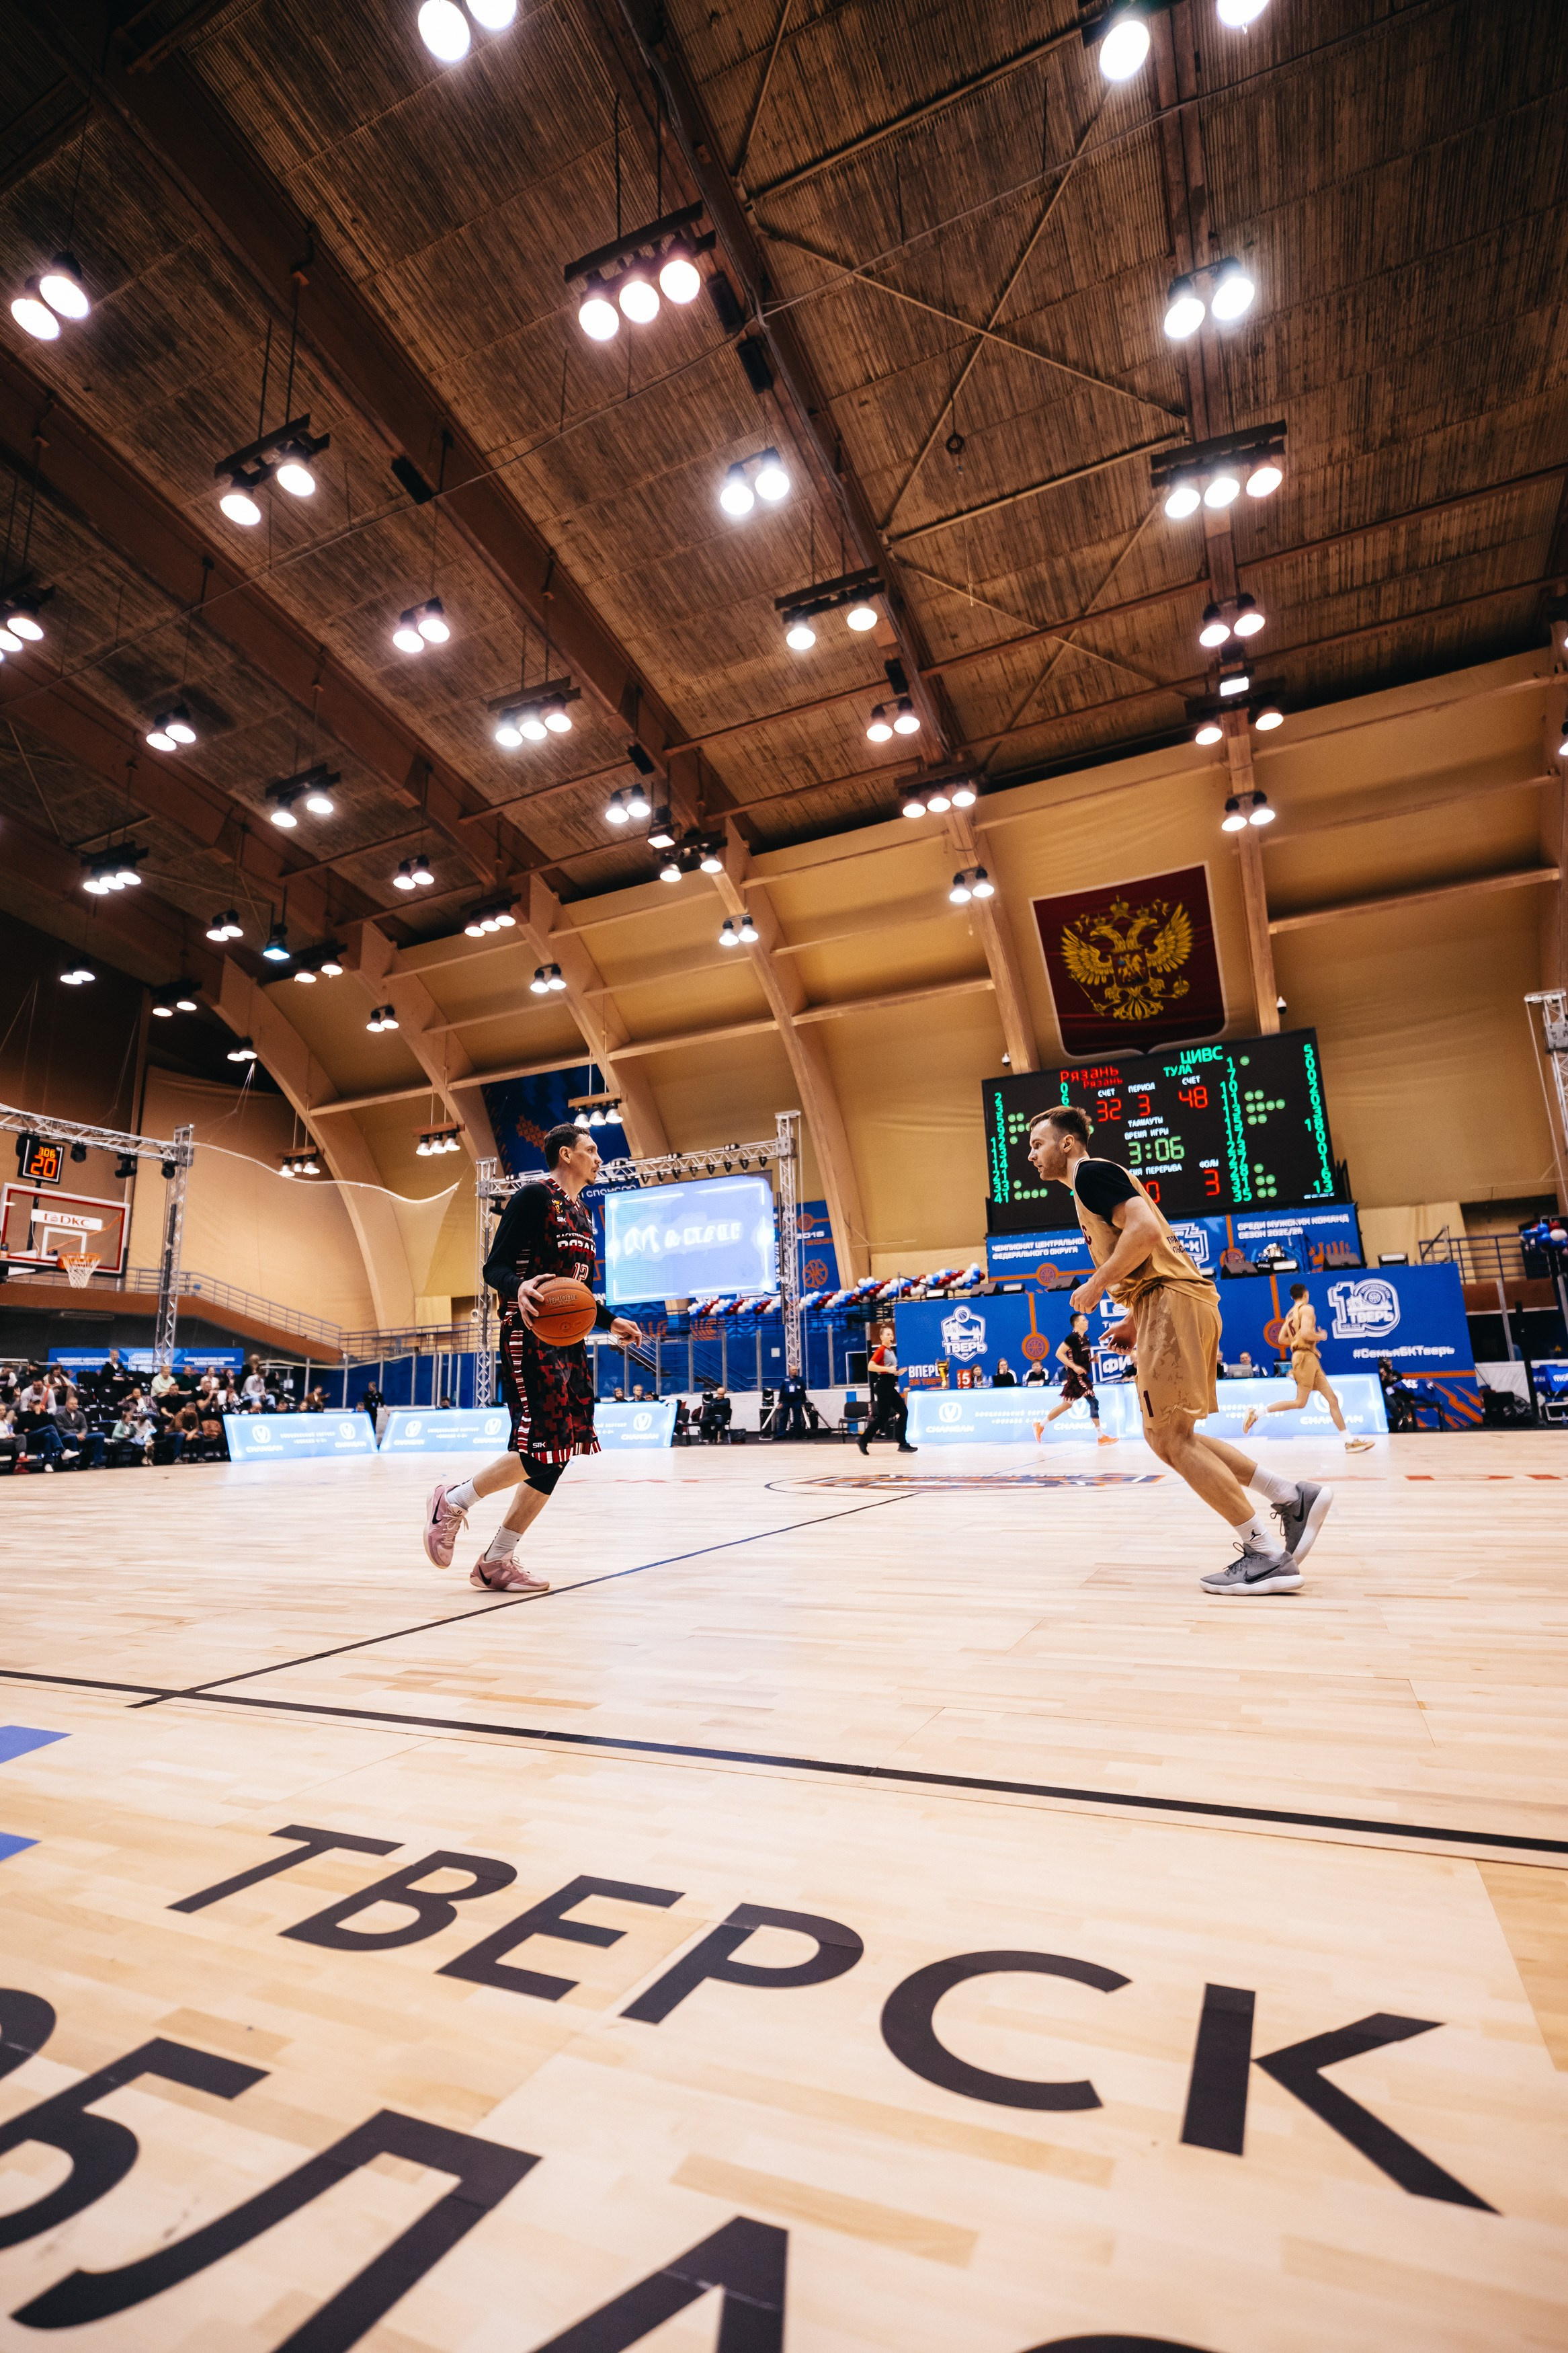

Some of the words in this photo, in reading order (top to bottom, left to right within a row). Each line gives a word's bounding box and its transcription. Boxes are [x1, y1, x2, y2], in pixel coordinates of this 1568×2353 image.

[1180, 1045, 1224, 1065] ЦИВС
[1303, 1043, 1313, 1058] 5
[1227, 1056, 1233, 1070] 1
[1305, 1057, 1315, 1070] 0
[1163, 1064, 1193, 1077] ТУЛА
[1227, 1068, 1236, 1081] 7
[1307, 1068, 1317, 1082] 0
[1182, 1075, 1200, 1085] СЧЕТ
[1060, 1082, 1069, 1094] 0
[1098, 1088, 1115, 1098] СЧЕТ
[1128, 1082, 1156, 1093] ПЕРИОД
[1220, 1080, 1238, 1094] 10
[1309, 1081, 1319, 1094] 2
[995, 1092, 1002, 1105] 2
[1061, 1093, 1070, 1107] 6
[1178, 1085, 1208, 1109] 48
[1311, 1093, 1320, 1106] 0
[995, 1104, 1003, 1115] 3
[1096, 1098, 1122, 1122] 32
[1137, 1094, 1151, 1117] 3
[1313, 1105, 1322, 1118] 3
[996, 1115, 1004, 1126] 5
[1128, 1116, 1163, 1127] ТАЙМАУТЫ
[997, 1125, 1005, 1138] 9
[1124, 1129, 1147, 1140] ВРЕМЯ
[1150, 1127, 1169, 1137] ИГРЫ
[1316, 1130, 1325, 1143] 0
[1128, 1135, 1185, 1165] 3:06
[1317, 1142, 1327, 1155] 0
[30, 1155, 57, 1178] 20
[1199, 1158, 1219, 1168] ФОЛЫ
[1320, 1154, 1327, 1167] 1
[1145, 1163, 1183, 1175] ПЕРЕРЫВА
[1321, 1166, 1331, 1180] 6
[1203, 1168, 1221, 1196] 3
[1313, 1179, 1333, 1194] 13
[1237, 1221, 1266, 1231] СРЕДИ
[1311, 1213, 1350, 1225] КОМАНД
[1238, 1230, 1266, 1240] СЕЗОН
[992, 1242, 1034, 1252] ЧЕМПИОНАТ
[992, 1249, 1049, 1261] ФЕДЕРАЛЬНОГО
[1050, 1246, 1079, 1255] ОКРУГА
[1348, 1310, 1395, 1324] ТВЕРЬ
[943, 1341, 987, 1354] ТВЕРЬ
[925, 1425, 975, 1433] CHANGAN
